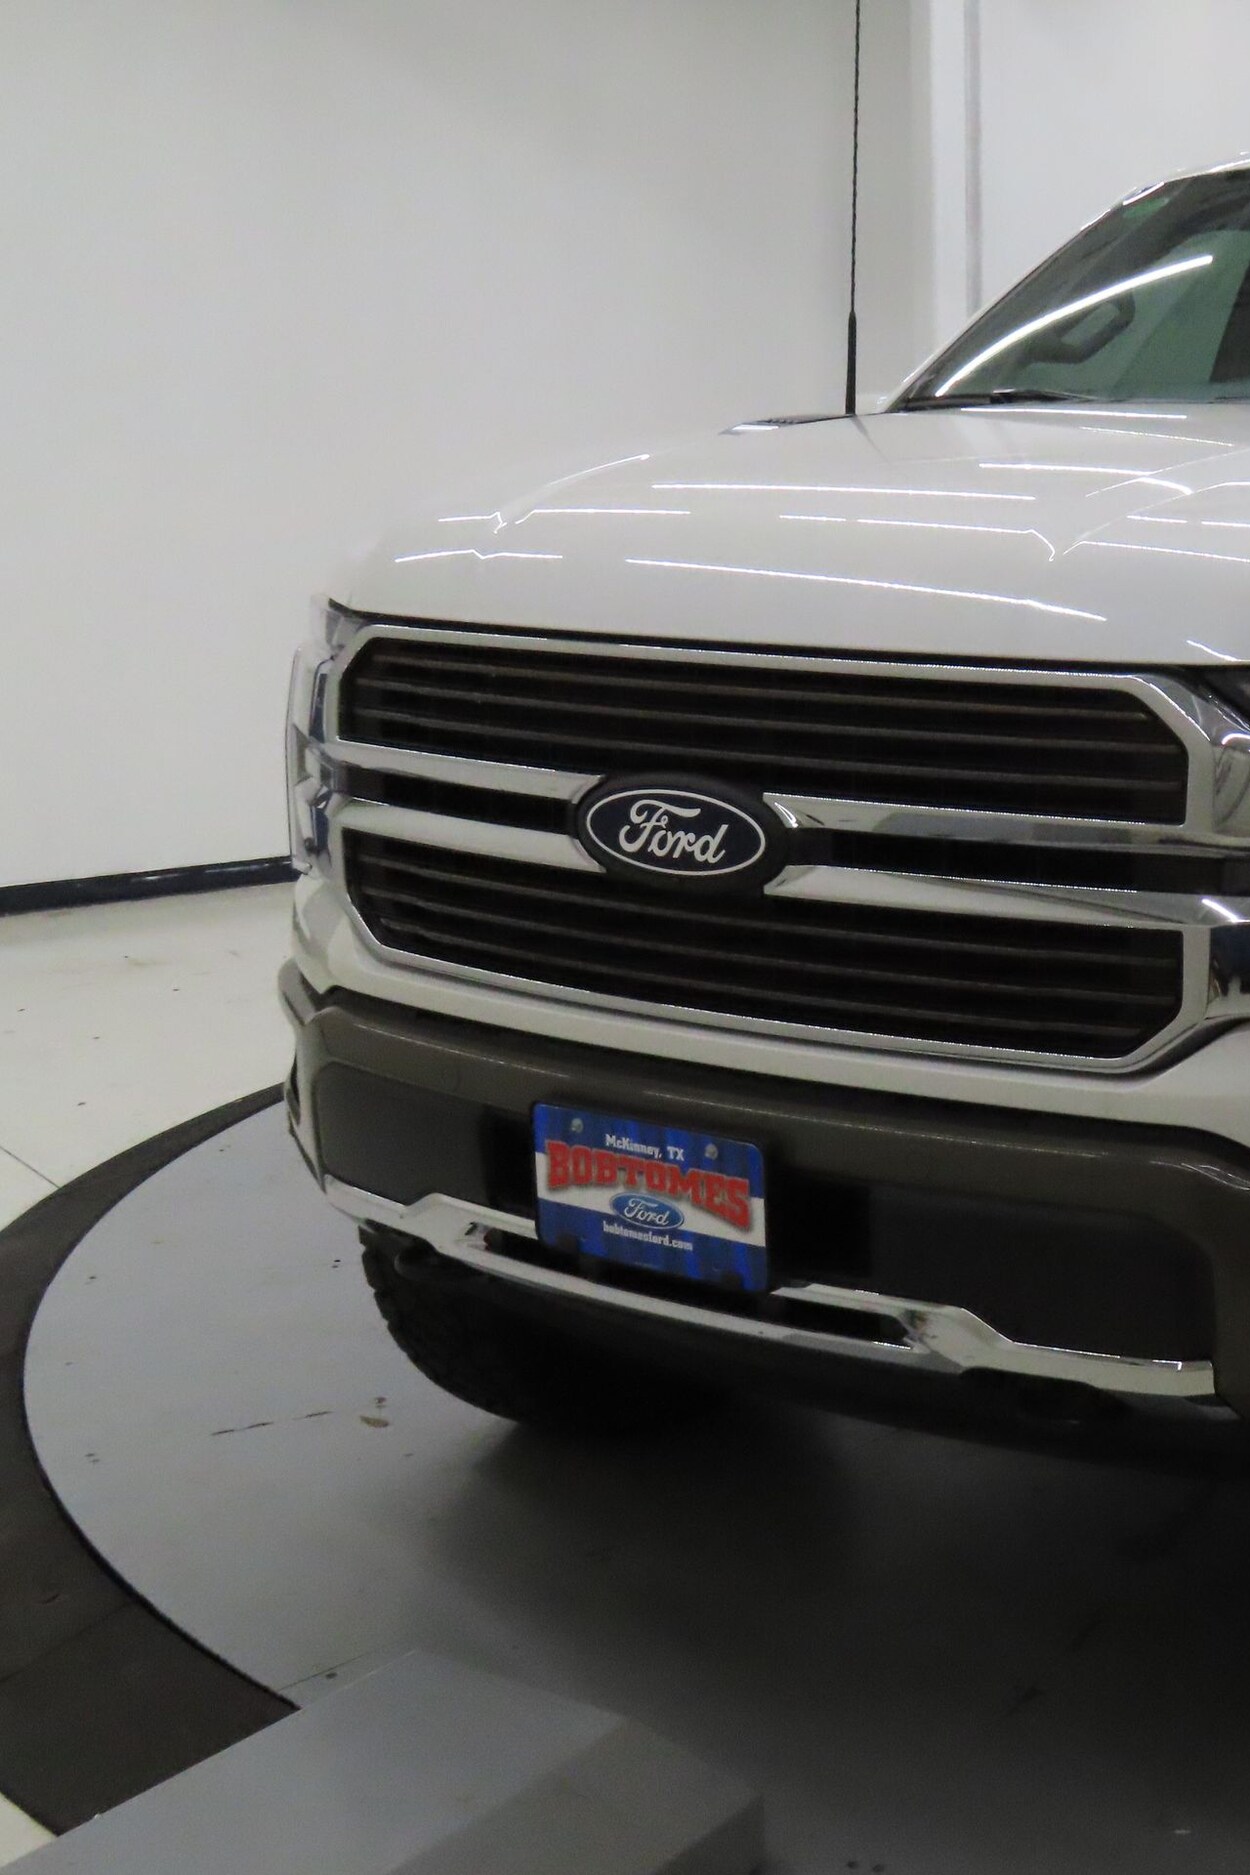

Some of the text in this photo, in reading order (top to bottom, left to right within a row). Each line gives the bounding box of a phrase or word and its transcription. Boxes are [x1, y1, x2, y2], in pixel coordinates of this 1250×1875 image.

[618, 799, 729, 864] Ford
[667, 1146, 685, 1161] TX
[624, 1198, 670, 1226] Ford
[603, 1220, 694, 1252] bobtomesford.com
